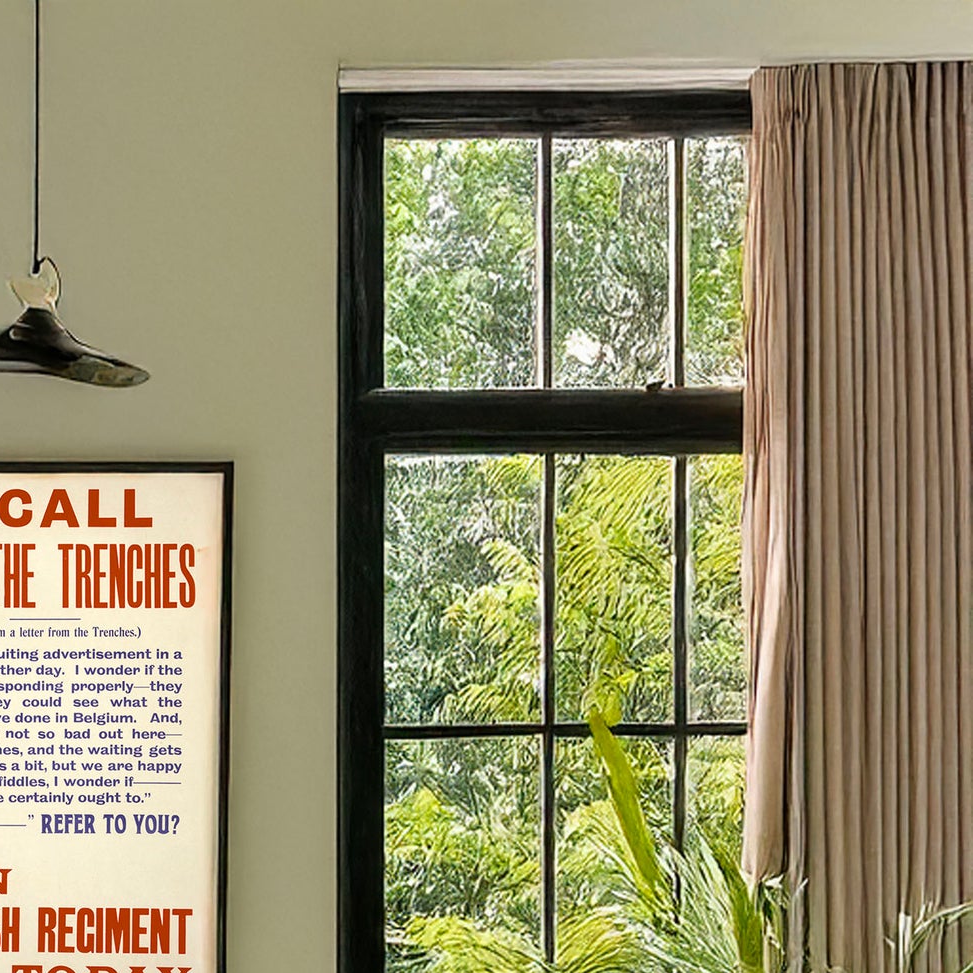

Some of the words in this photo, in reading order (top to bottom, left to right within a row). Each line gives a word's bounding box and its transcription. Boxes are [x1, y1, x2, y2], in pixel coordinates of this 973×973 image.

[58, 544, 195, 608] TRENCHES
[10, 629, 15, 638] a
[20, 626, 44, 638] letter
[49, 626, 69, 638] from
[75, 626, 88, 638] the
[93, 626, 141, 639] Trenches.)
[43, 648, 151, 660] advertisement
[157, 648, 169, 660] in
[174, 650, 182, 660] a
[36, 664, 64, 678] day.
[75, 664, 79, 677] I
[84, 664, 140, 676] wonder
[145, 664, 155, 676] if
[158, 664, 182, 676] the
[23, 696, 61, 708] could
[73, 698, 98, 708] see
[110, 696, 147, 708] what
[158, 696, 182, 708] the
[15, 712, 50, 724] done
[56, 712, 67, 723] in
[74, 712, 136, 726] Belgium.
[150, 712, 182, 726] And,
[6, 728, 29, 740] not
[38, 730, 55, 740] so
[65, 728, 90, 740] bad
[99, 728, 123, 740] out
[28, 744, 54, 756] and
[59, 744, 83, 756] the
[88, 744, 142, 757] waiting
[149, 744, 182, 758] gets
[11, 762, 20, 772] a
[25, 759, 47, 773] bit,
[52, 760, 76, 772] but
[81, 762, 102, 772] we
[108, 762, 133, 772] are
[138, 761, 182, 774] happy
[54, 775, 58, 788] I
[64, 775, 120, 788] wonder
[9, 792, 73, 805] certainly
[78, 792, 121, 805] ought
[41, 814, 95, 833] REFER
[103, 814, 126, 834] TO
[133, 814, 180, 834] YOU?
[38, 907, 193, 954] REGIMENT
